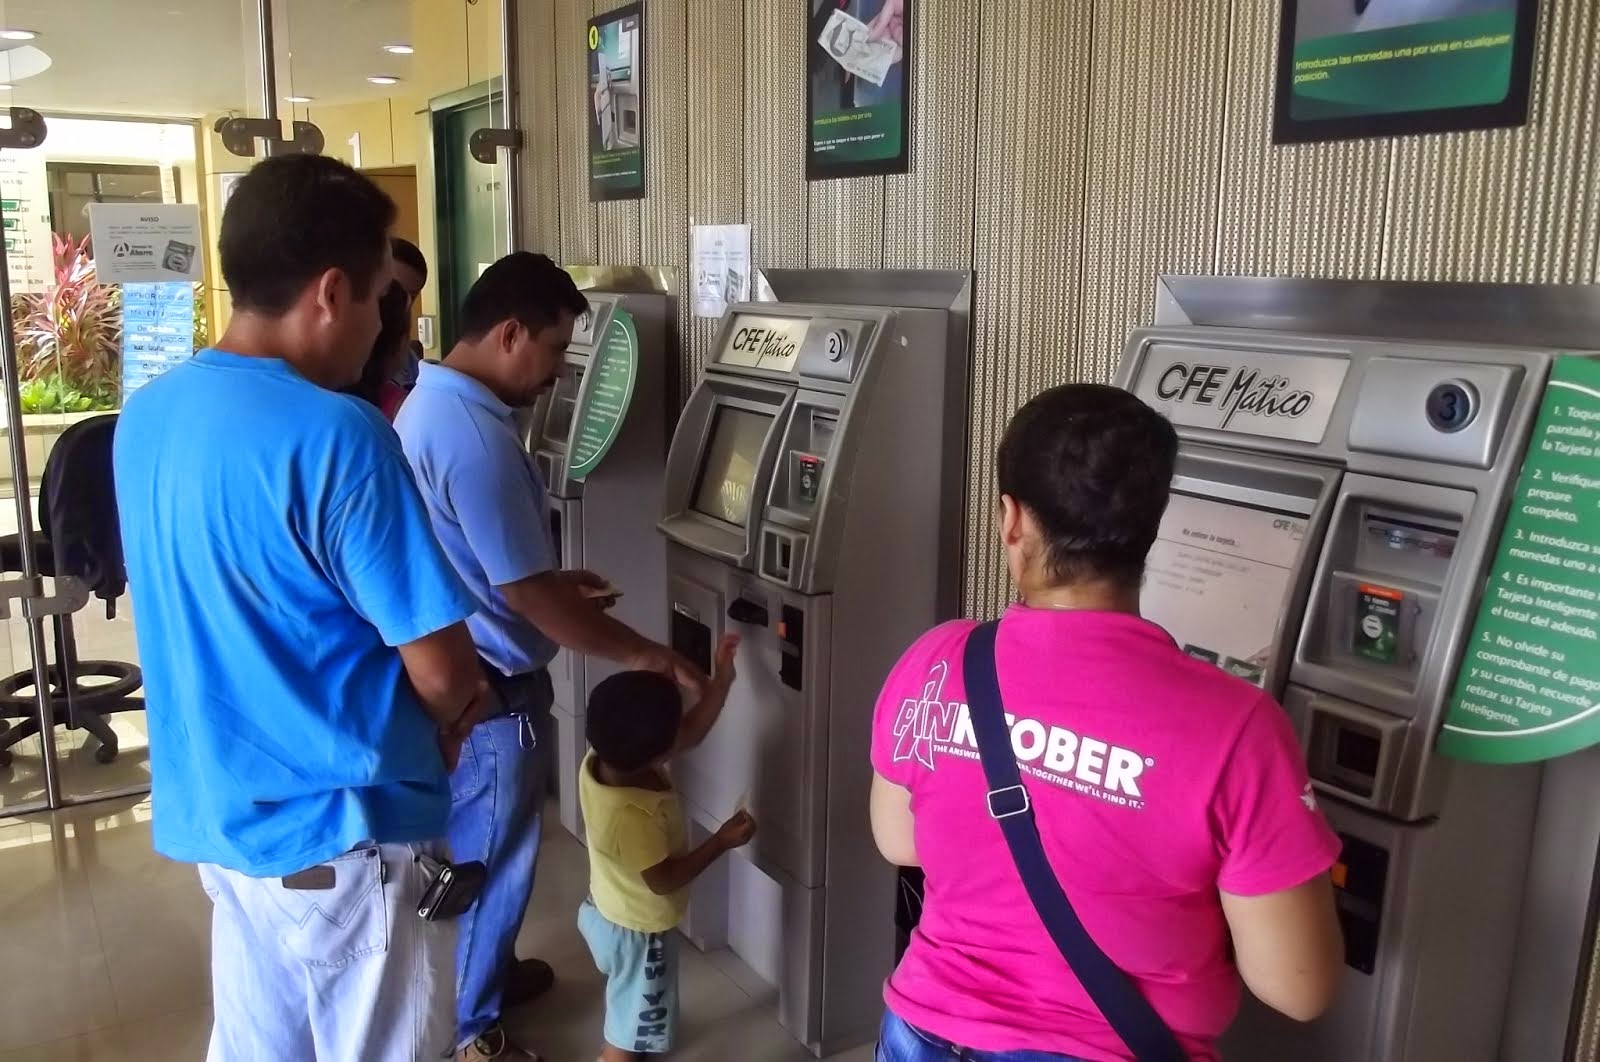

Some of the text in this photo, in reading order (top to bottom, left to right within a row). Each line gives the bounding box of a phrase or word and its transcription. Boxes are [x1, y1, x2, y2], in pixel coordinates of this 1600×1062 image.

[1296, 58, 1338, 70] Introduzca
[1353, 50, 1393, 63] monedas
[1394, 49, 1412, 57] una
[1413, 46, 1429, 56] por
[1429, 43, 1448, 52] una
[1450, 41, 1462, 50] en
[348, 132, 361, 168] 1
[732, 328, 765, 352] CFE
[829, 338, 836, 354] 2
[1156, 362, 1230, 404] CFE
[1439, 391, 1457, 421] 3
[1546, 424, 1593, 438] pantalla
[1542, 439, 1552, 451] la
[1555, 441, 1592, 456] Tarjeta
[1527, 488, 1572, 503] prepare
[1522, 505, 1578, 523] completo.
[1529, 531, 1590, 552] Introduzca
[1509, 548, 1596, 573] monedas uno a
[1516, 573, 1528, 585] Es
[1530, 577, 1596, 600] importante
[1491, 606, 1502, 616] el
[1503, 608, 1530, 622] total
[1530, 616, 1550, 627] del
[1498, 587, 1598, 620] Tarjeta Inteligente
[1496, 635, 1512, 648] No
[1514, 641, 1549, 657] olvide
[1551, 651, 1565, 661] su
[1476, 650, 1551, 677] comprobante
[1552, 669, 1568, 681] de
[1466, 684, 1552, 716] retirar su Tarjeta
[1470, 667, 1592, 708] y su cambio, recuerde
[894, 699, 1144, 798] PINKOBER
[933, 744, 948, 753] THE
[1031, 767, 1074, 789] TOGETHER
[1075, 782, 1100, 797] WE'LL
[1102, 791, 1126, 805] FIND
